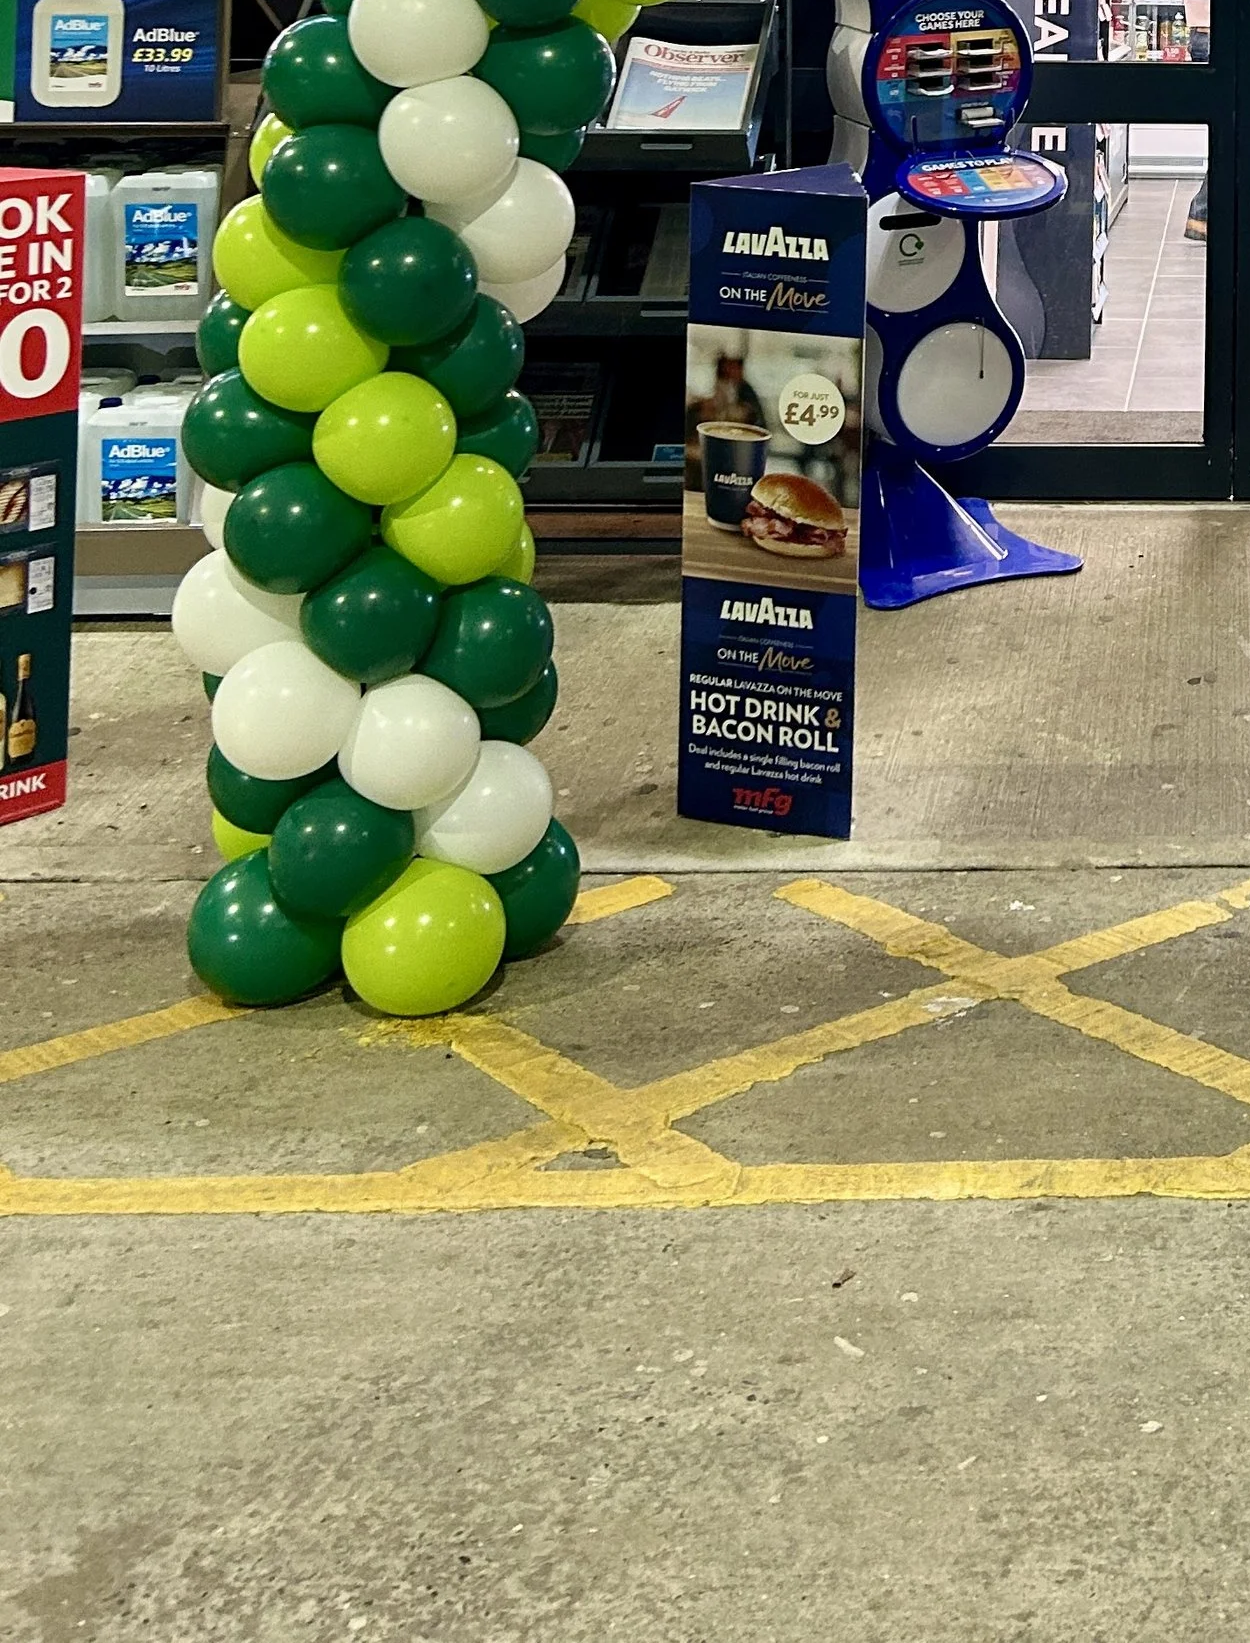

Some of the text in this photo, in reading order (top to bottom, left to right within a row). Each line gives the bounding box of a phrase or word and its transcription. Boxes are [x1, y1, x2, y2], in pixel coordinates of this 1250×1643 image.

[915, 10, 984, 23] CHOOSE YOUR
[919, 19, 980, 31] GAMES HERE
[131, 47, 193, 62] £33.99
[644, 44, 746, 63] Observer
[921, 157, 1014, 171] GAMES TO PLAY
[722, 226, 829, 261] LAVAZZA
[28, 239, 73, 276] IN
[56, 276, 73, 299] 2
[719, 282, 830, 312] ON THE Move
[794, 390, 829, 401] FOR JUST
[784, 403, 839, 426] £4.99
[714, 473, 753, 486] LAVAZZA
[720, 597, 813, 629] LAVAZZA
[717, 646, 815, 672] ON THE Move
[690, 673, 843, 702] REGULAR LAVAZZA ON THE MOVE
[690, 690, 842, 729] HOT DRINK &
[692, 714, 839, 753] BACON ROLL
[688, 743, 708, 755] Deal
[708, 746, 742, 761] includes
[800, 759, 825, 772] bacon
[826, 763, 841, 773] roll
[704, 760, 720, 770] and
[721, 763, 750, 775] regular
[784, 771, 799, 781] hot
[732, 788, 793, 816] mfg
